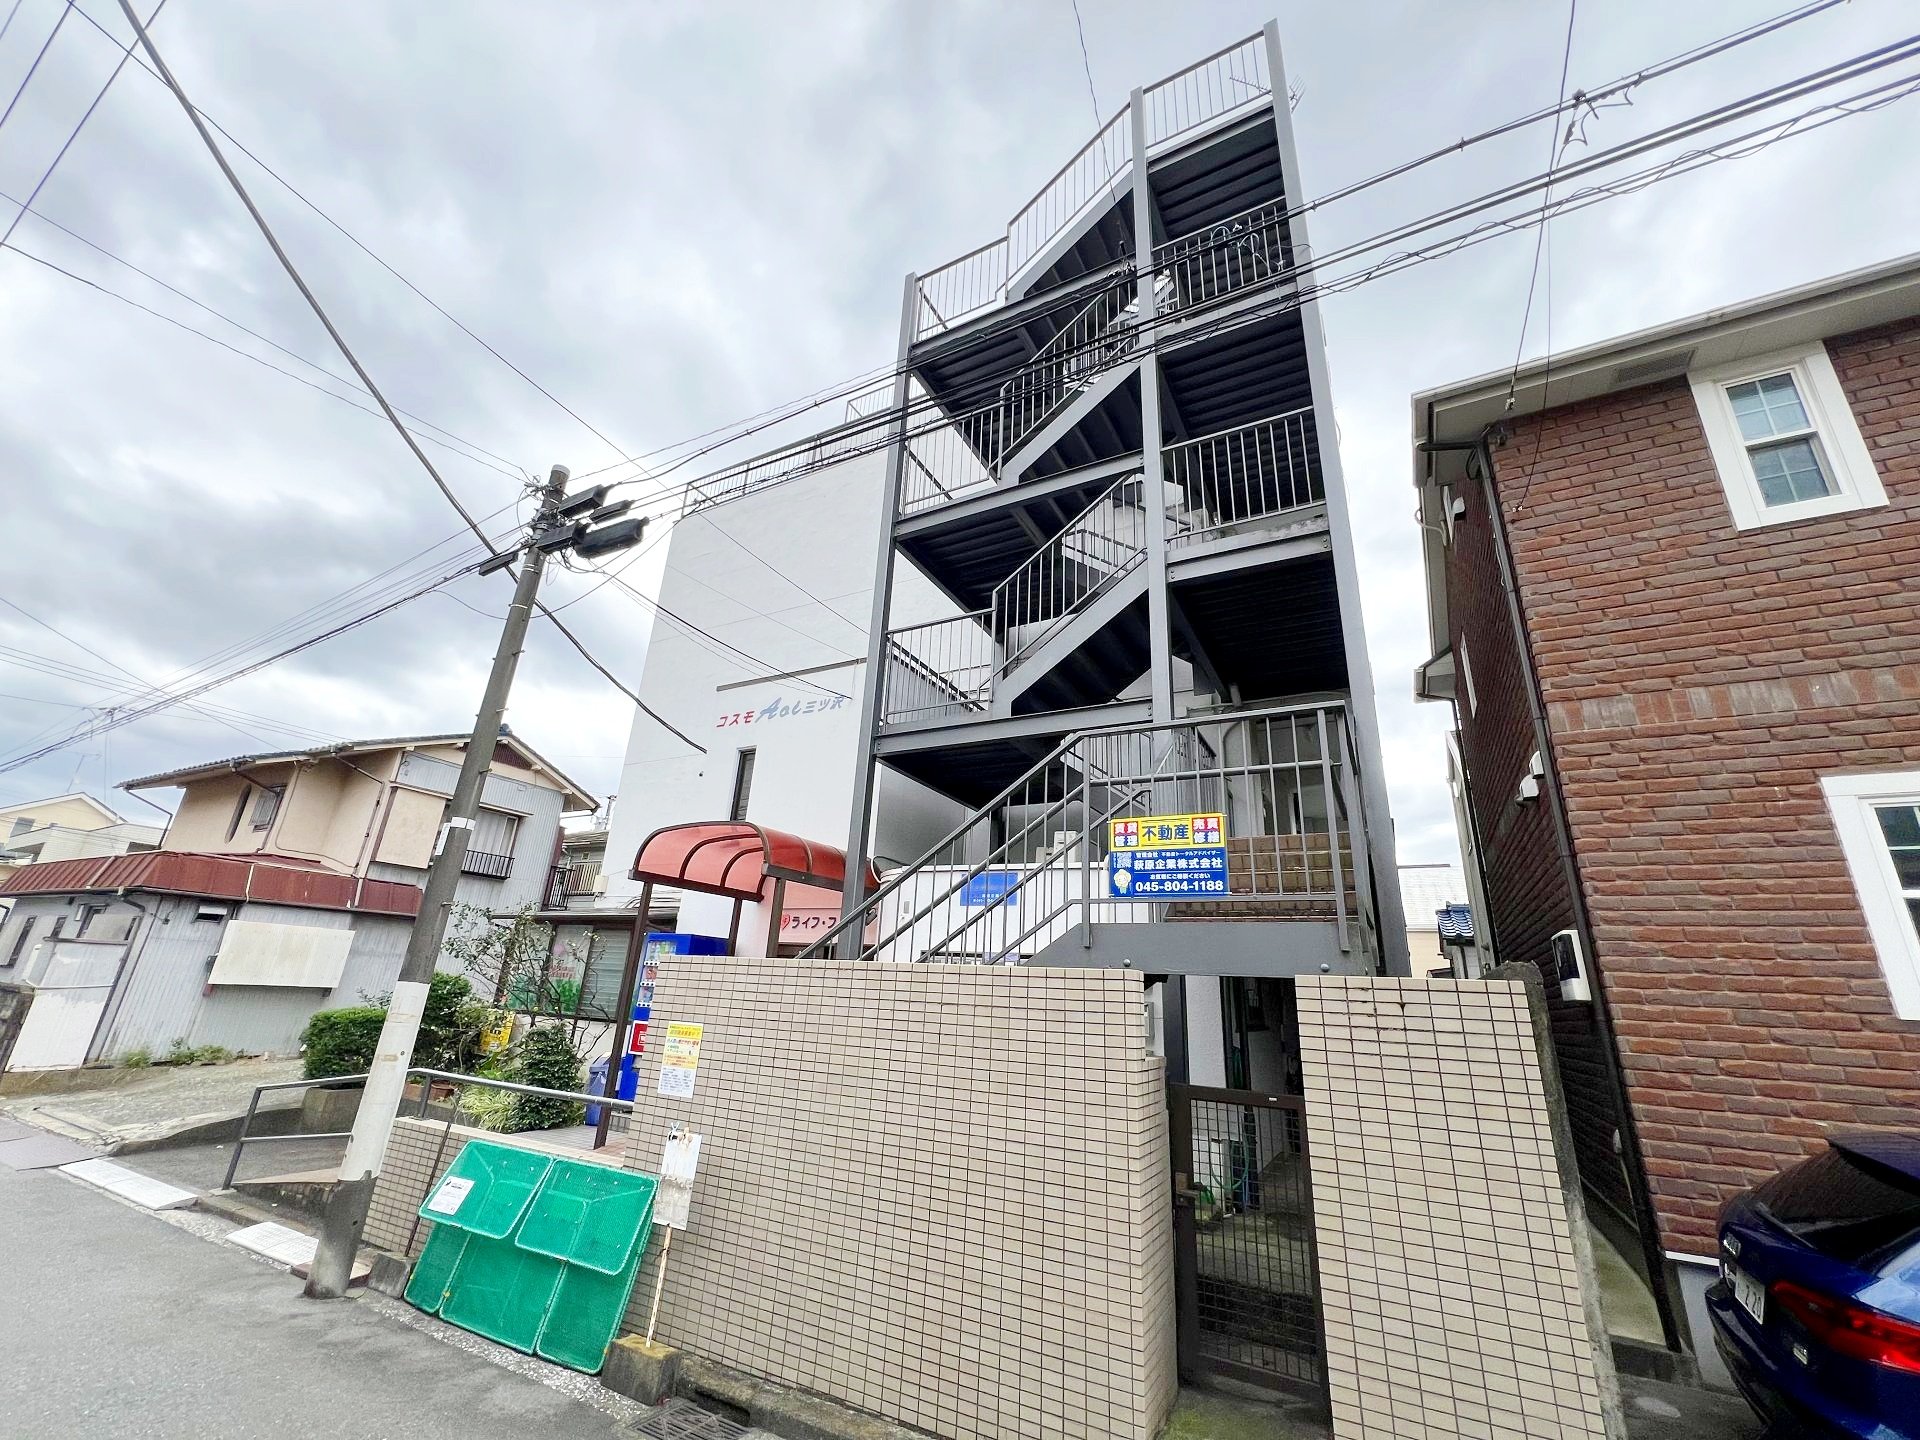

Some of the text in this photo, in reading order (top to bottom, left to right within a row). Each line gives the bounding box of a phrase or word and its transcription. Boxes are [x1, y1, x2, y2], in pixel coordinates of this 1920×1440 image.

[1141, 824, 1190, 841] 不動産
[1135, 880, 1224, 893] 045-804-1188
